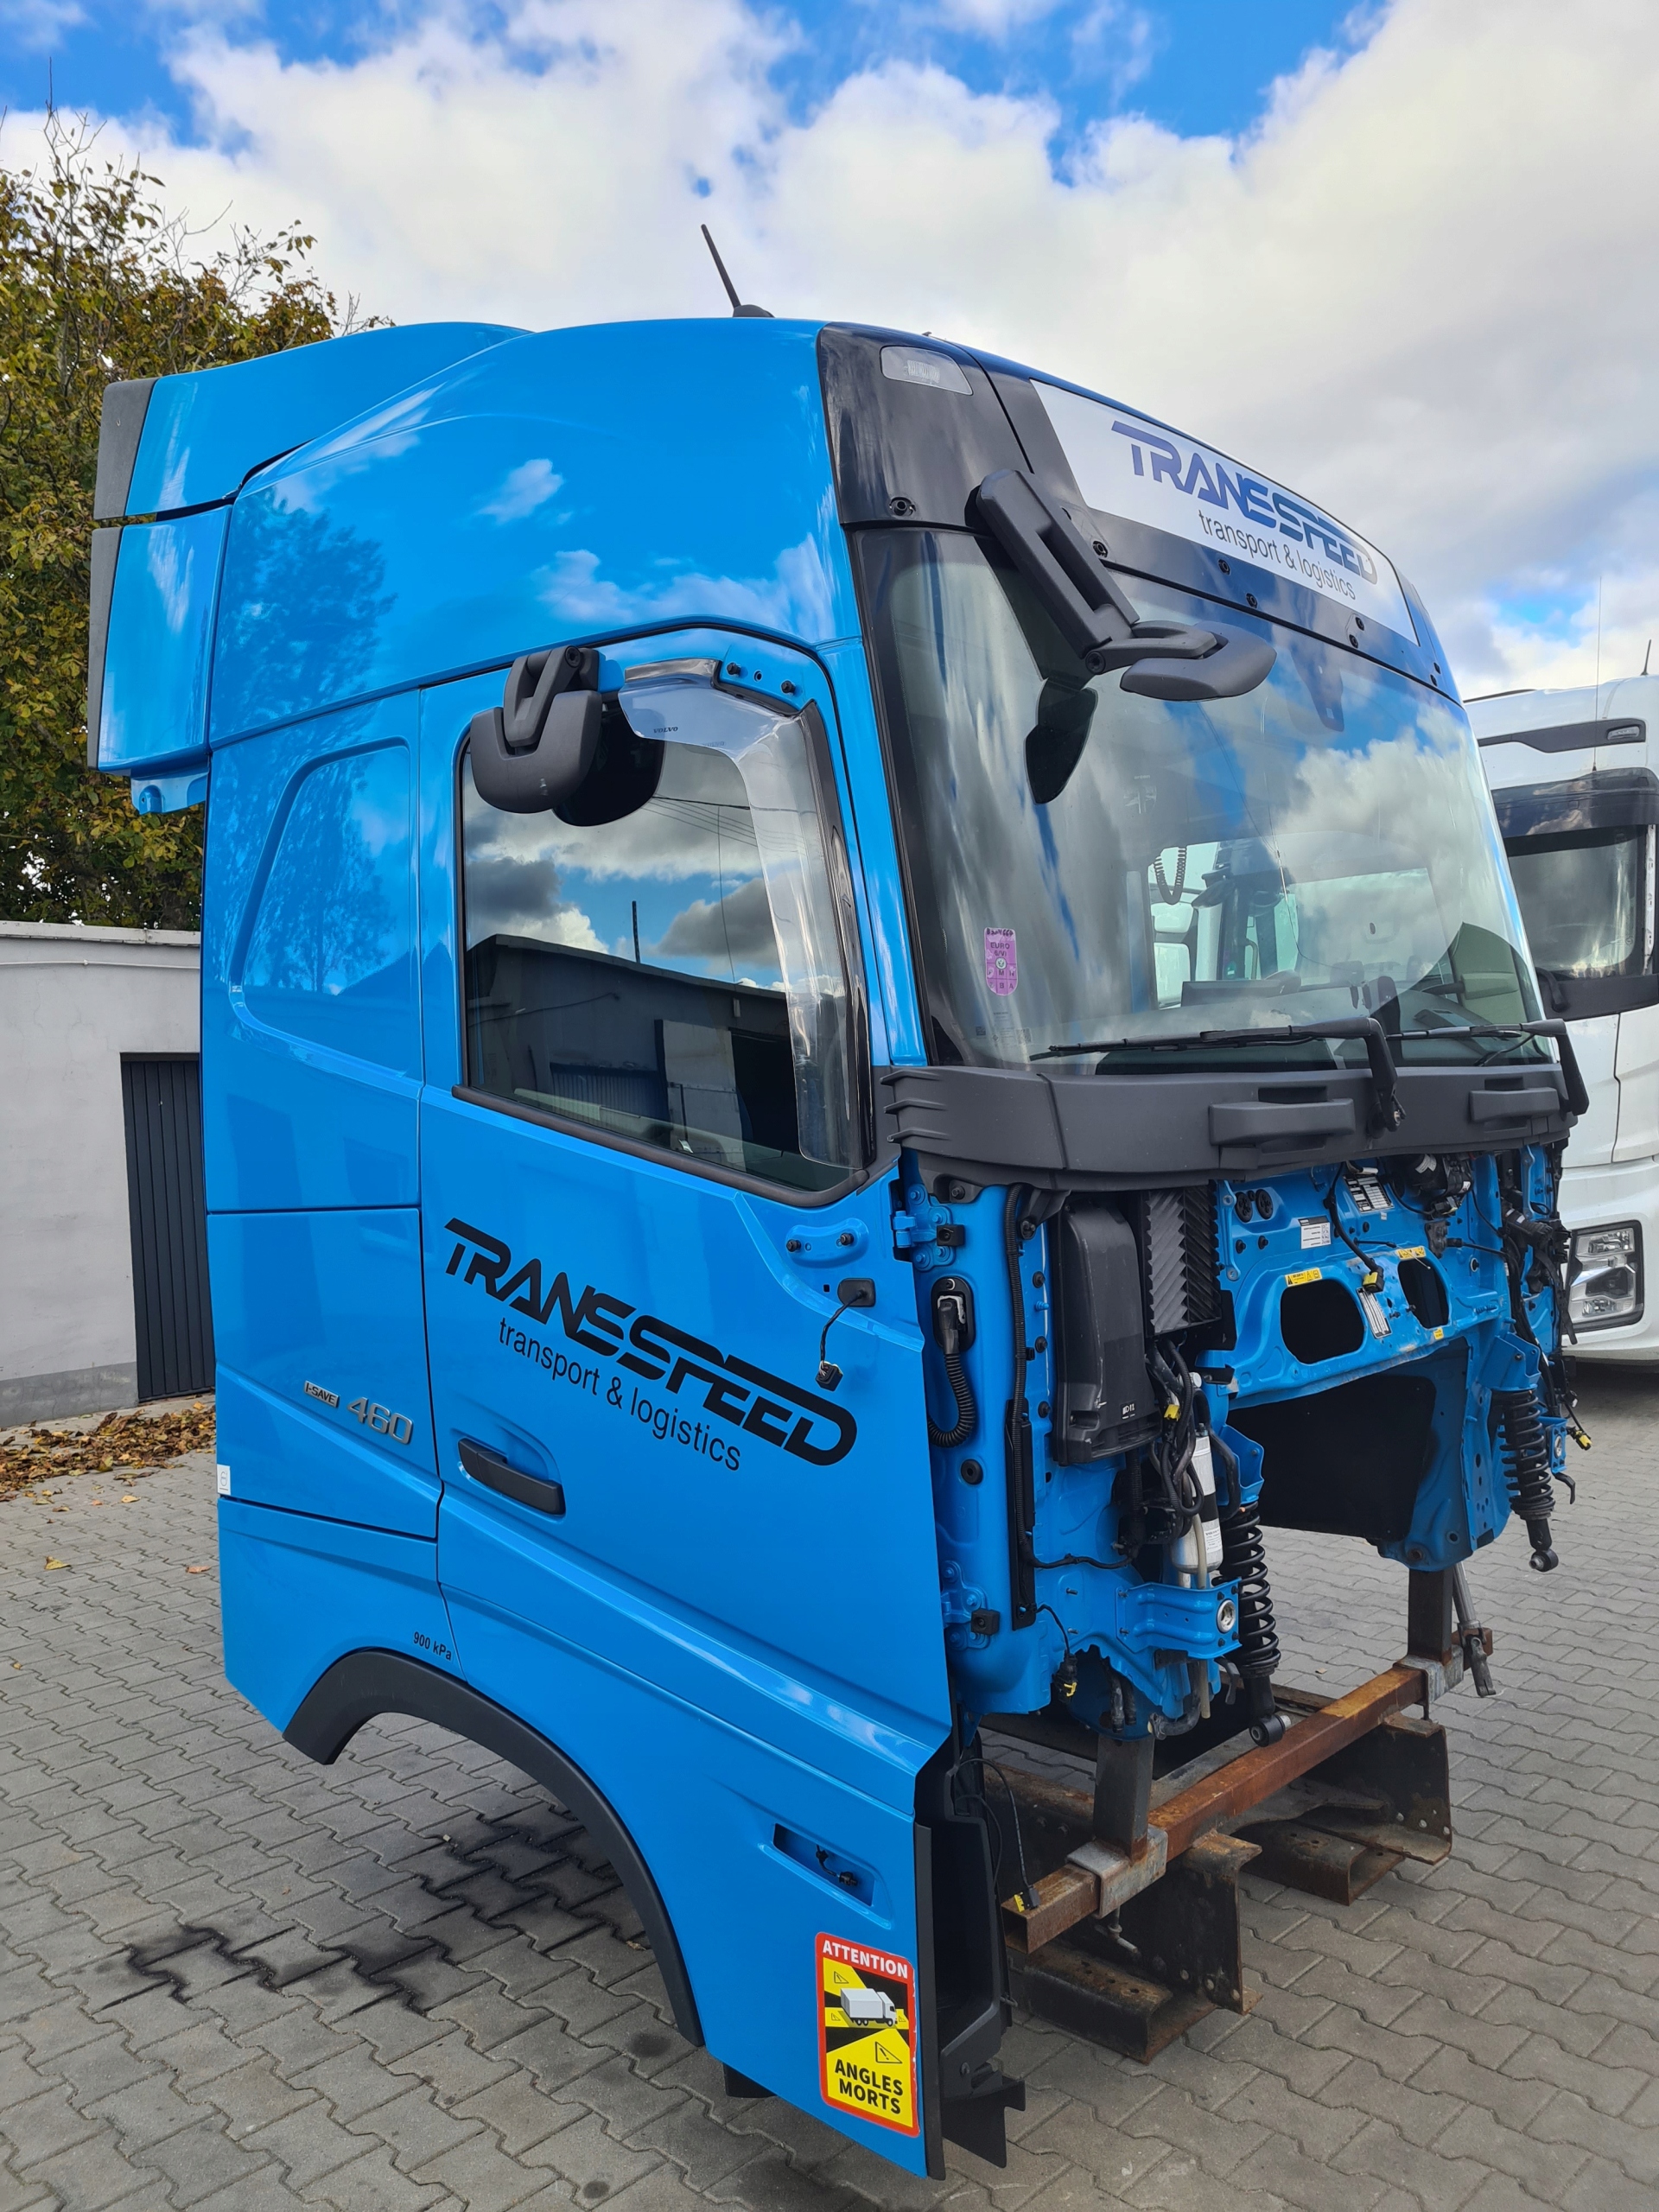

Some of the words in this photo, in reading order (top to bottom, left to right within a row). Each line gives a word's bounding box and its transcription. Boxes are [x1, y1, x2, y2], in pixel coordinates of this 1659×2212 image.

[1111, 420, 1377, 585] TRANSSPEED
[1198, 509, 1281, 563] transport
[1282, 543, 1297, 569] &
[1297, 547, 1357, 601] logistics
[443, 1217, 858, 1466] TRANSSPEED
[305, 1382, 336, 1406] I-SAVE
[346, 1396, 414, 1445] 460
[499, 1317, 600, 1395] transport
[606, 1377, 623, 1409] &
[630, 1388, 741, 1471] logistics
[413, 1630, 430, 1650] 900
[433, 1639, 452, 1662] kPa
[823, 1939, 908, 1980] ATTENTION
[835, 2058, 903, 2096] ANGLES
[839, 2078, 901, 2115] MORTS
